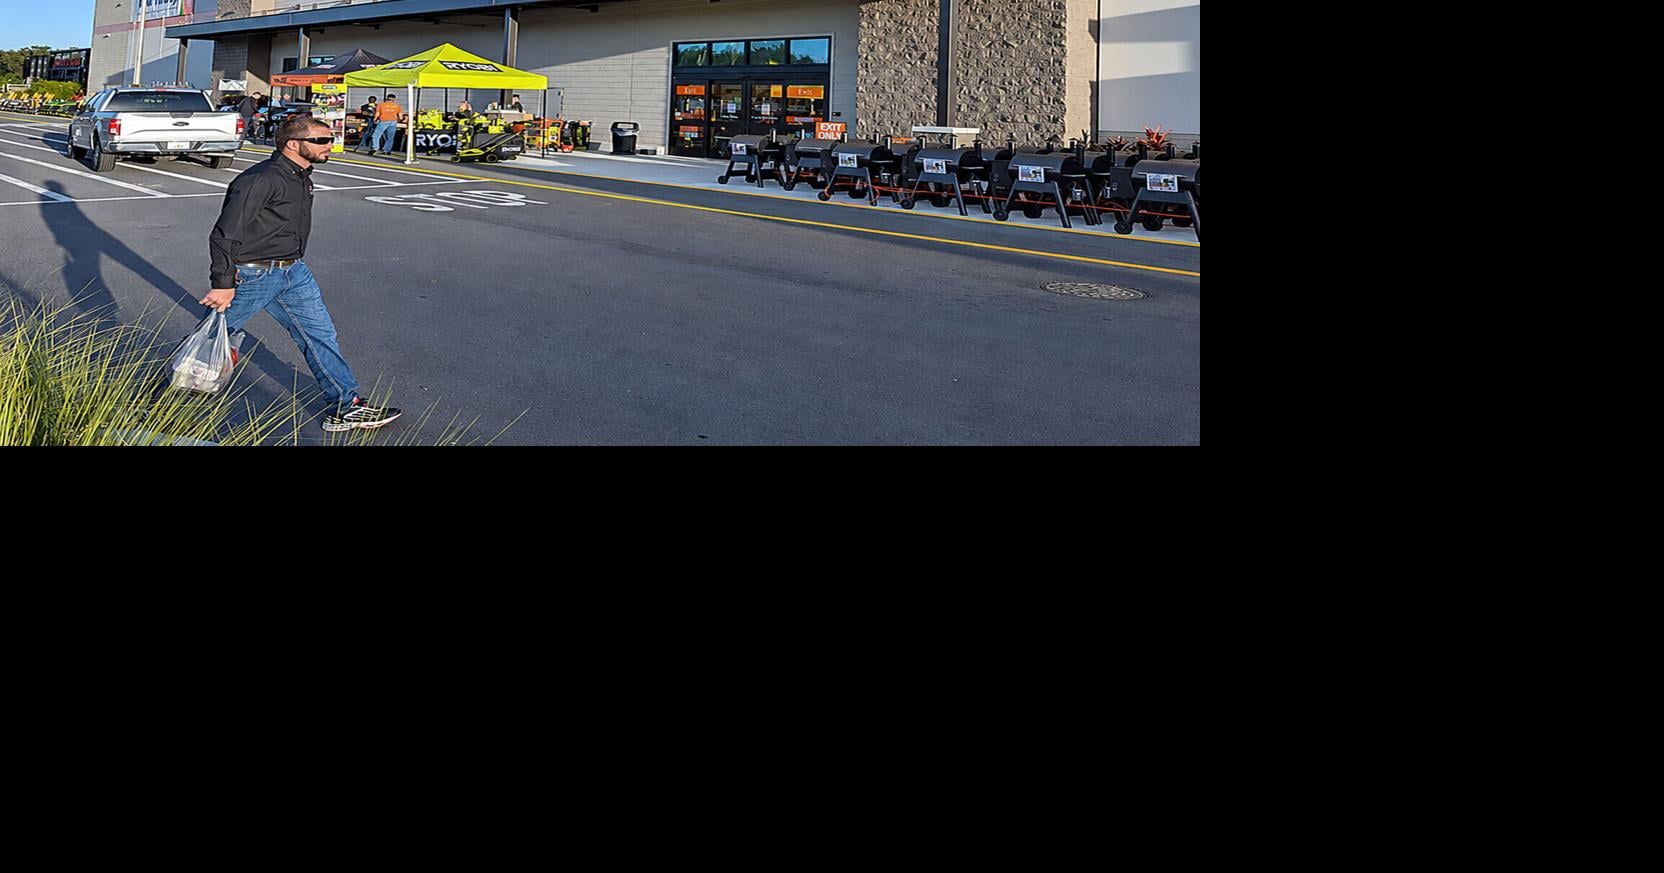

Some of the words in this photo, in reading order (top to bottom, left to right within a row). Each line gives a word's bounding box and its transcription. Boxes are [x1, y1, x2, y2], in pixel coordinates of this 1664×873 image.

[443, 61, 500, 72] RYOBI
[798, 88, 813, 96] Exit
[820, 122, 843, 131] EXIT
[818, 131, 843, 140] ONLY
[364, 190, 549, 212] STOP
